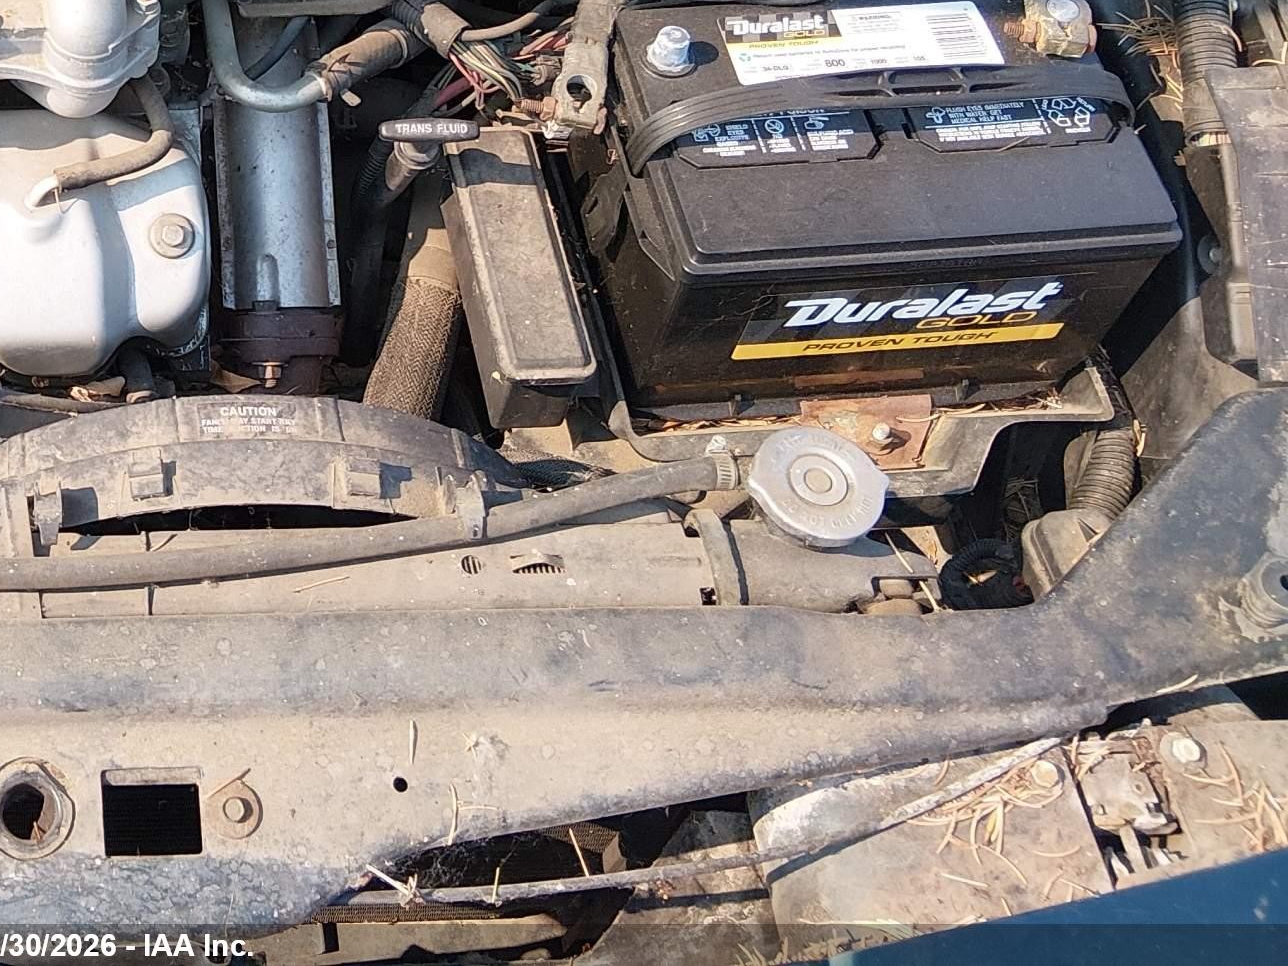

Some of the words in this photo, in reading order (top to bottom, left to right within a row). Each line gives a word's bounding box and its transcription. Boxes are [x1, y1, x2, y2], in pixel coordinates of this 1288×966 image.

[726, 14, 825, 36] Duralast
[783, 29, 825, 38] GOLD
[394, 123, 433, 135] TRANS
[436, 123, 469, 134] FLUID
[783, 282, 1063, 327] Duralast
[916, 312, 1037, 330] GOLD
[803, 337, 904, 351] PROVEN
[912, 331, 993, 344] TOUGH
[219, 406, 277, 417] CAUTION
[250, 418, 277, 426] START
[202, 426, 224, 434] TIME
